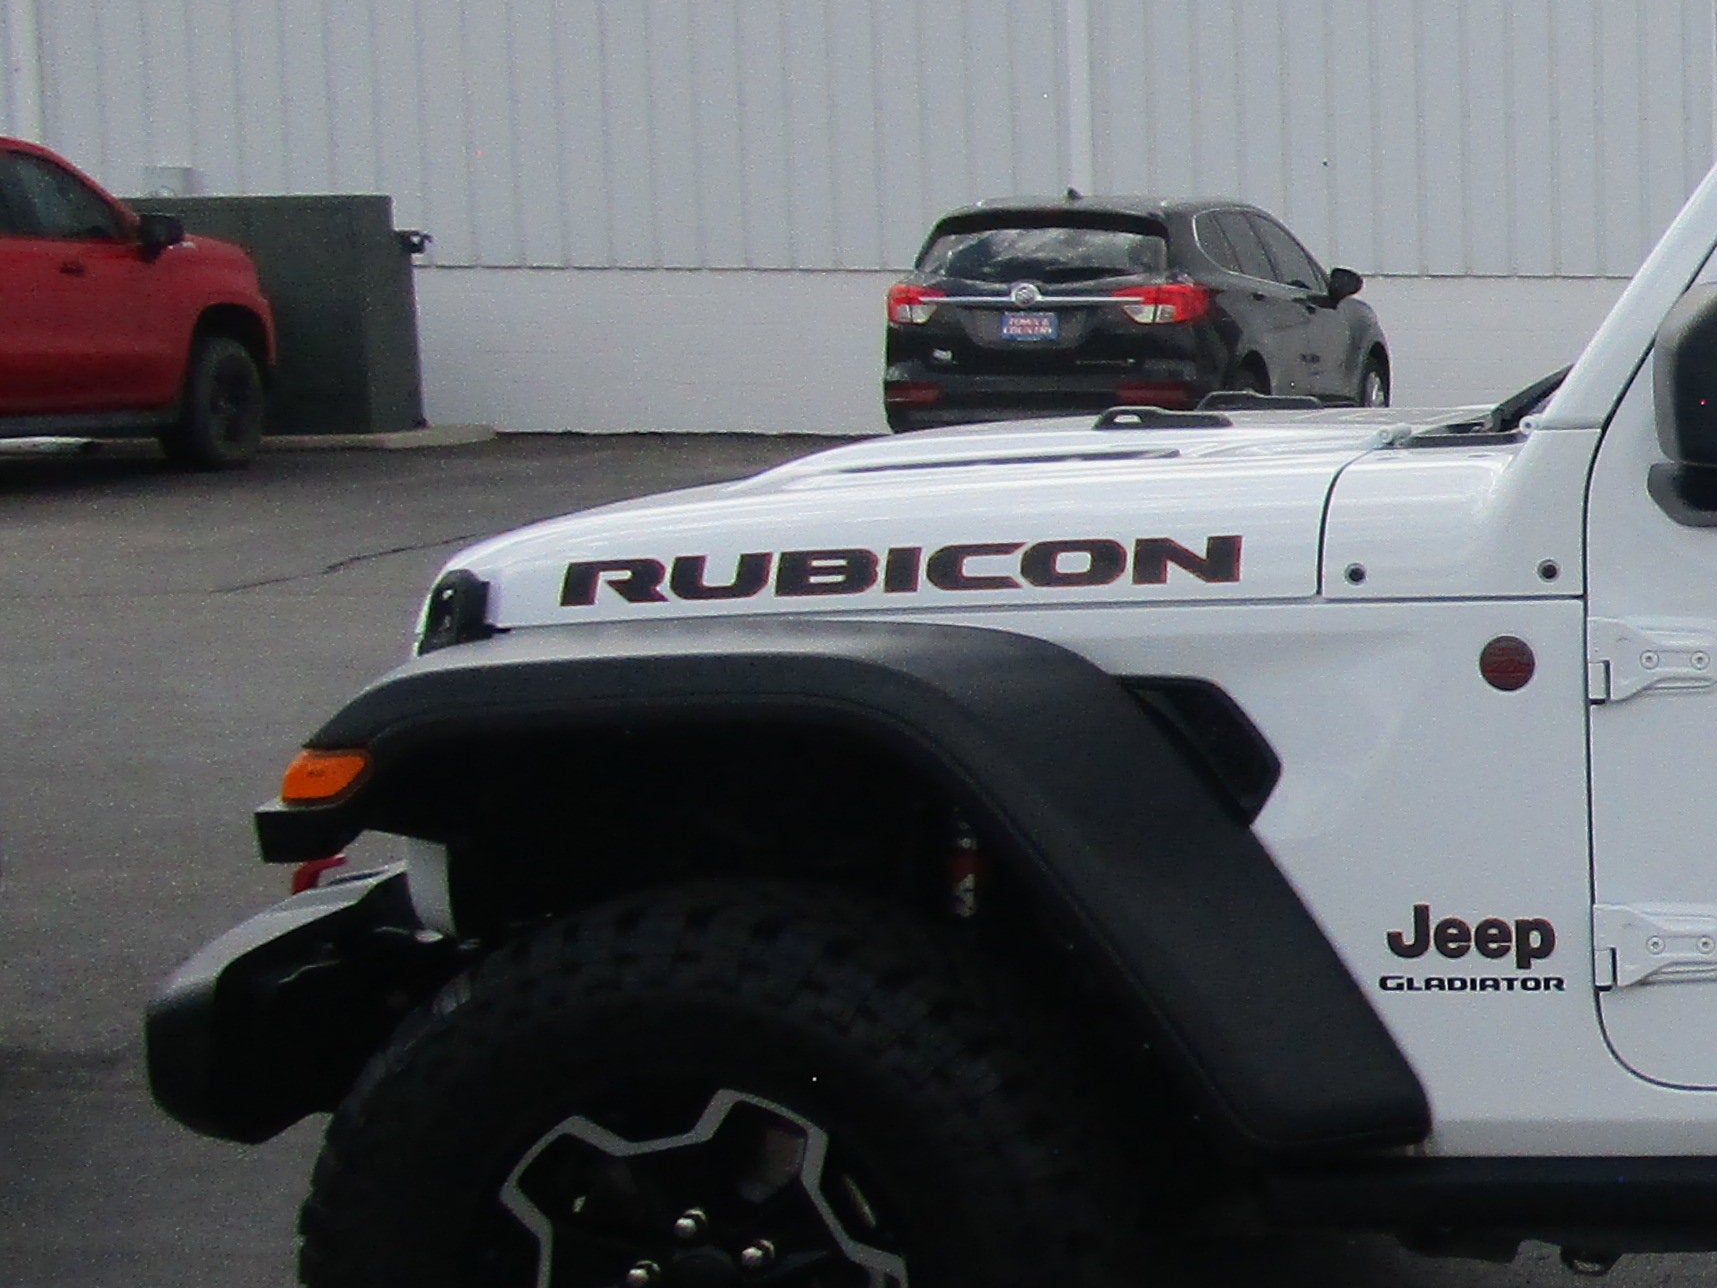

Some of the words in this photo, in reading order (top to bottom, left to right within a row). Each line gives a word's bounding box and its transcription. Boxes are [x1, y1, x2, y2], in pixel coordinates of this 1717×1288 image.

[558, 534, 1244, 607] RUBICON
[1386, 903, 1556, 970] Jeep
[1378, 975, 1566, 992] GLADIATOR
